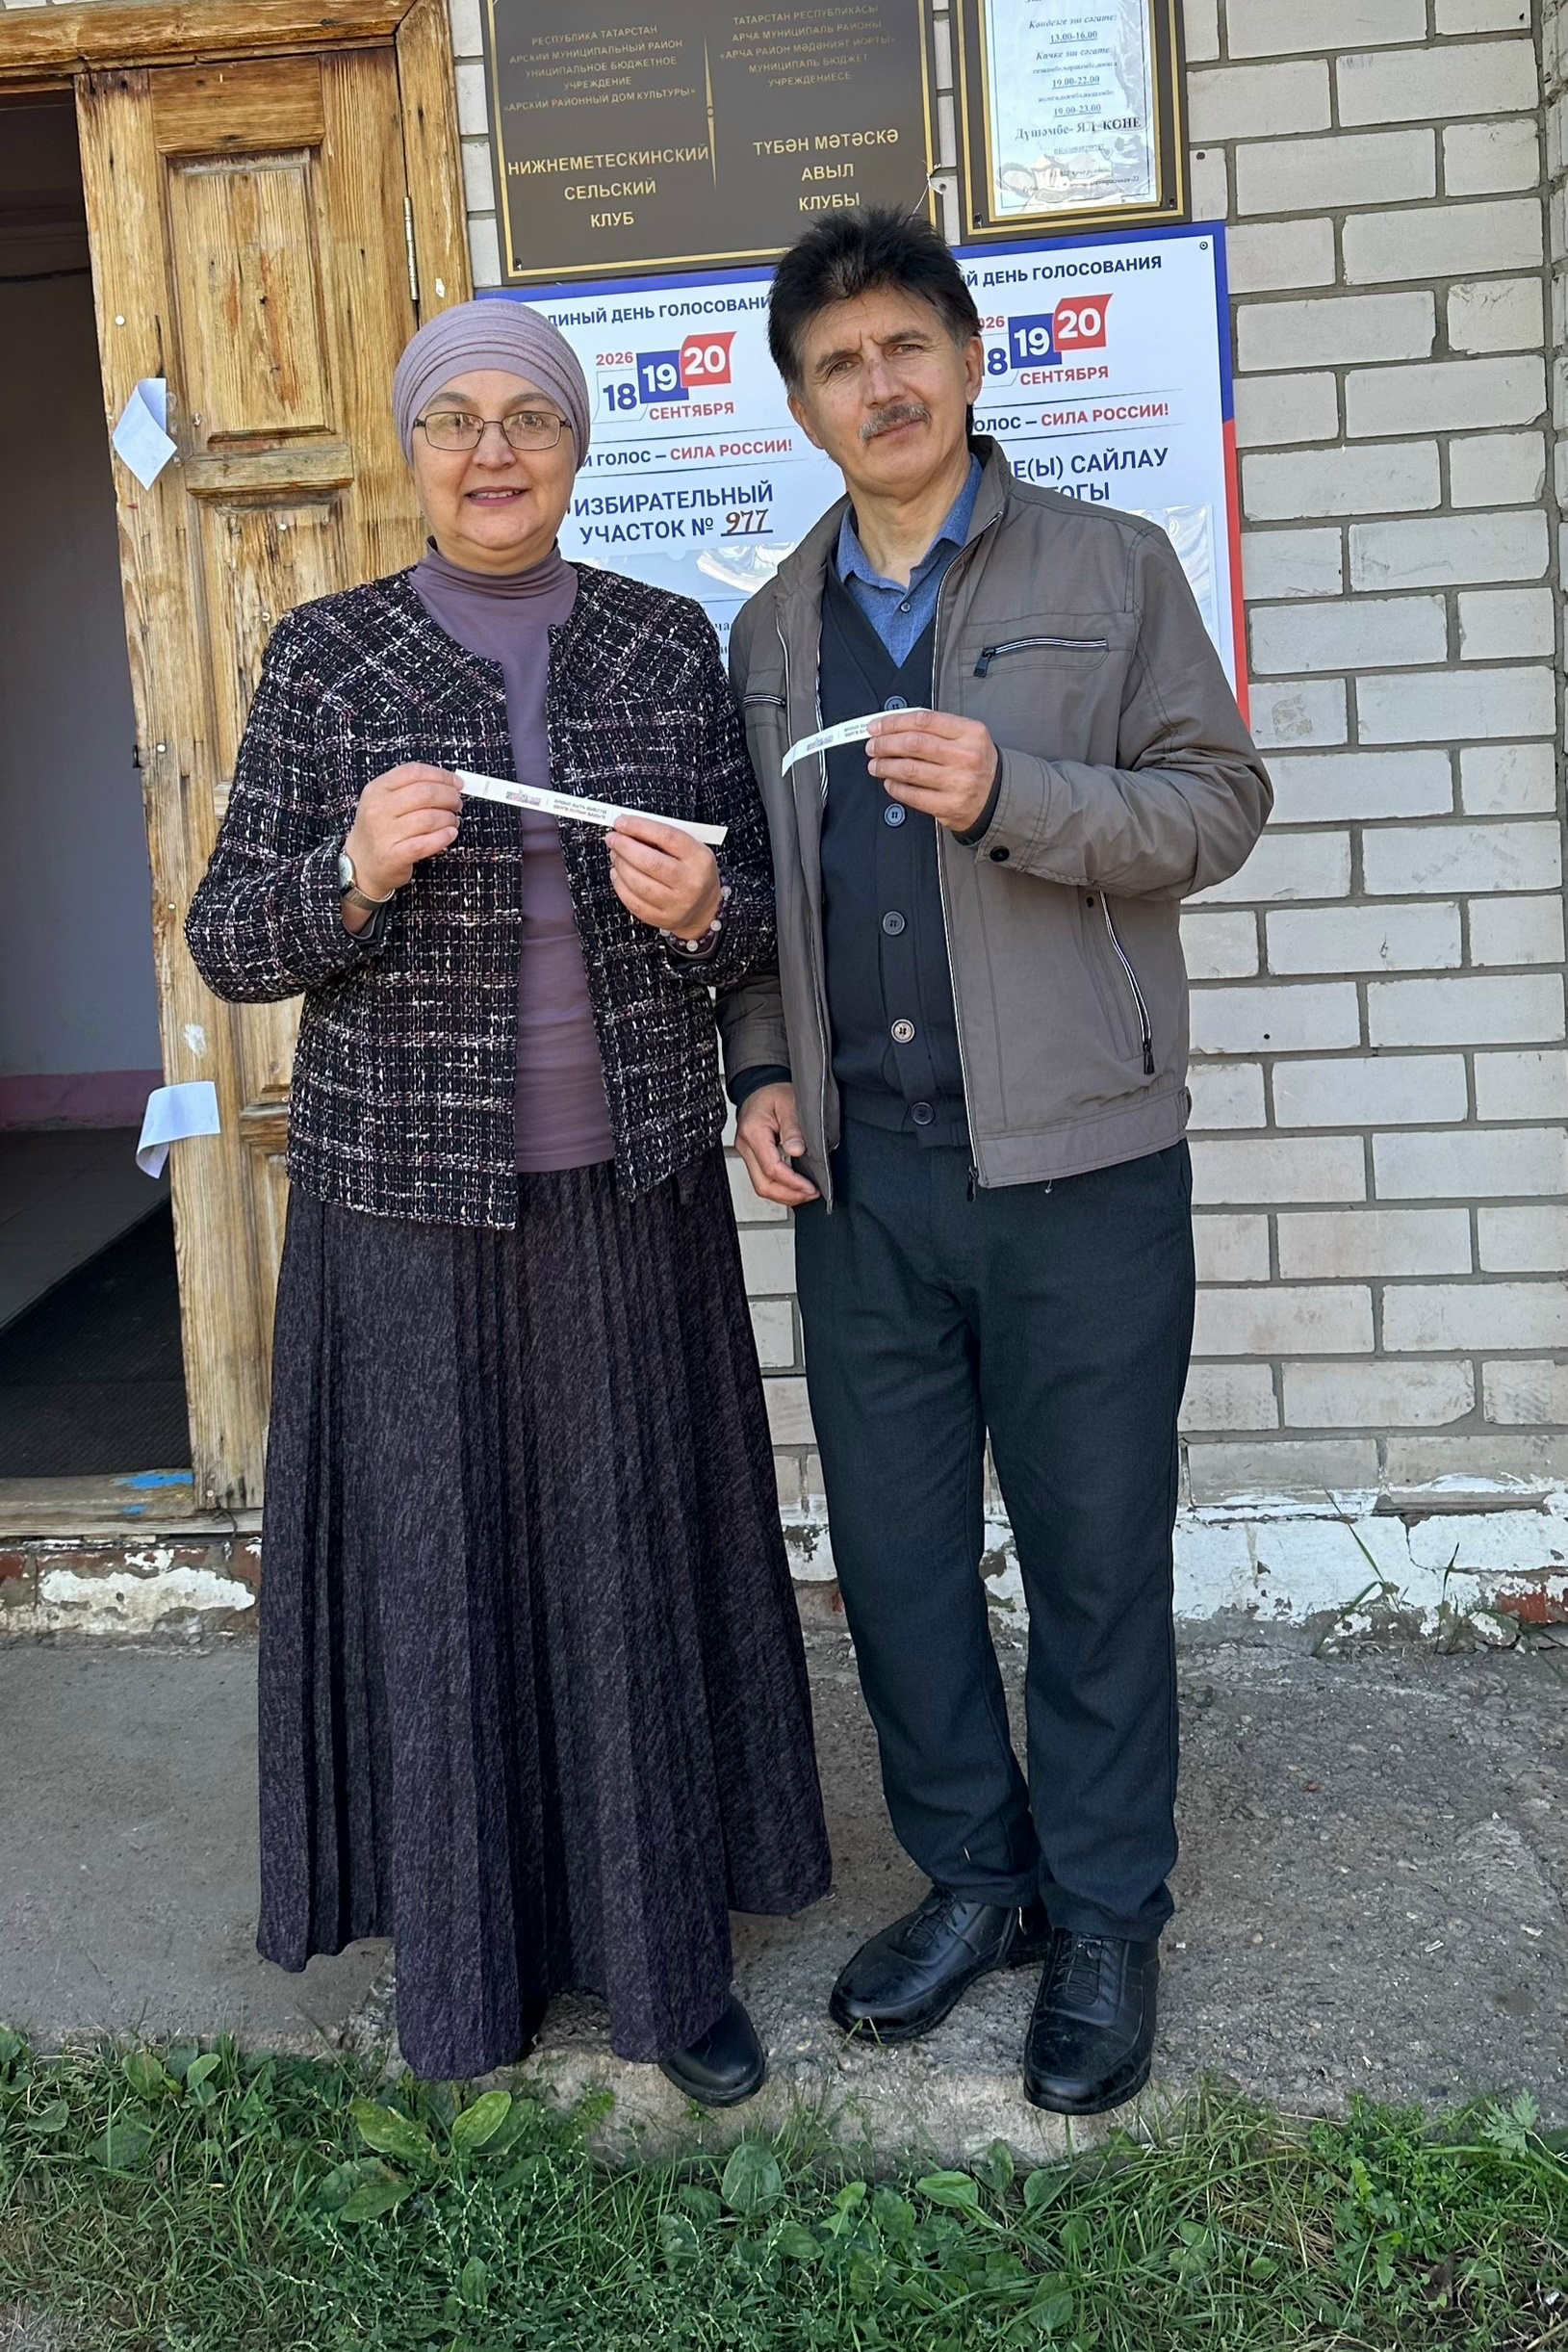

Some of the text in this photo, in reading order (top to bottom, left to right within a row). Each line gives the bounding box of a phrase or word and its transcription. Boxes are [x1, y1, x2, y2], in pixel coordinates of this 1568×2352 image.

[733, 5, 879, 26] ТАТАРСТАН РЕСПУБЛИКАСЫ
[531, 25, 657, 46] РЕСПУБЛИКА ТАТАРСТАН
[732, 32, 760, 42] АРЧА
[762, 26, 834, 39] МУНИЦИПАЛЬ
[610, 56, 677, 71] БЮДЖЕТНОЕ
[748, 59, 820, 74] МУНИЦИПАЛЬ
[563, 76, 632, 90] УЧРЕЖДЕНИЕ
[768, 71, 851, 88] УЧРЕЖДЕНИЕСЕ
[611, 91, 635, 104] ДОМ
[1102, 116, 1142, 130] КӨНЕ
[753, 128, 899, 156] ТҮБӘН МӘТӘСКӘ
[507, 142, 709, 176] НИЖНЕМЕТЕСКИНСКИЙ
[801, 163, 855, 181] АВЫЛ
[564, 176, 656, 200] СЕЛЬСКИЙ
[798, 192, 861, 211] КЛУБЫ
[590, 211, 635, 228] КЛУБ
[983, 269, 1028, 287] ДЕНЬ
[1032, 255, 1162, 280] ГОЛОСОВАНИЯ
[548, 297, 771, 327] ДИНЫЙ ДЕНЬ ГОЛОСОВАНИ
[979, 316, 1005, 329] 026
[983, 307, 1102, 376] 8 19 20
[596, 351, 633, 366] 2026
[603, 344, 727, 411] 18 19 20
[1019, 365, 1109, 386] СЕНТЯБРЯ
[649, 401, 734, 421] СЕНТЯБРЯ
[974, 417, 1021, 432] ОЛОС
[1041, 410, 1089, 426] СИЛА
[1092, 402, 1169, 422] РОССИИ!
[597, 450, 652, 467] ГОЛОС
[670, 446, 715, 460] СИЛА
[720, 439, 792, 456] РОССИИ!
[1011, 448, 1169, 482] Е(Ы) САЙЛАУ
[575, 479, 774, 517] ИЗБИРАТЕЛЬНЫЙ
[579, 508, 769, 545] УЧАСТОК № 977
